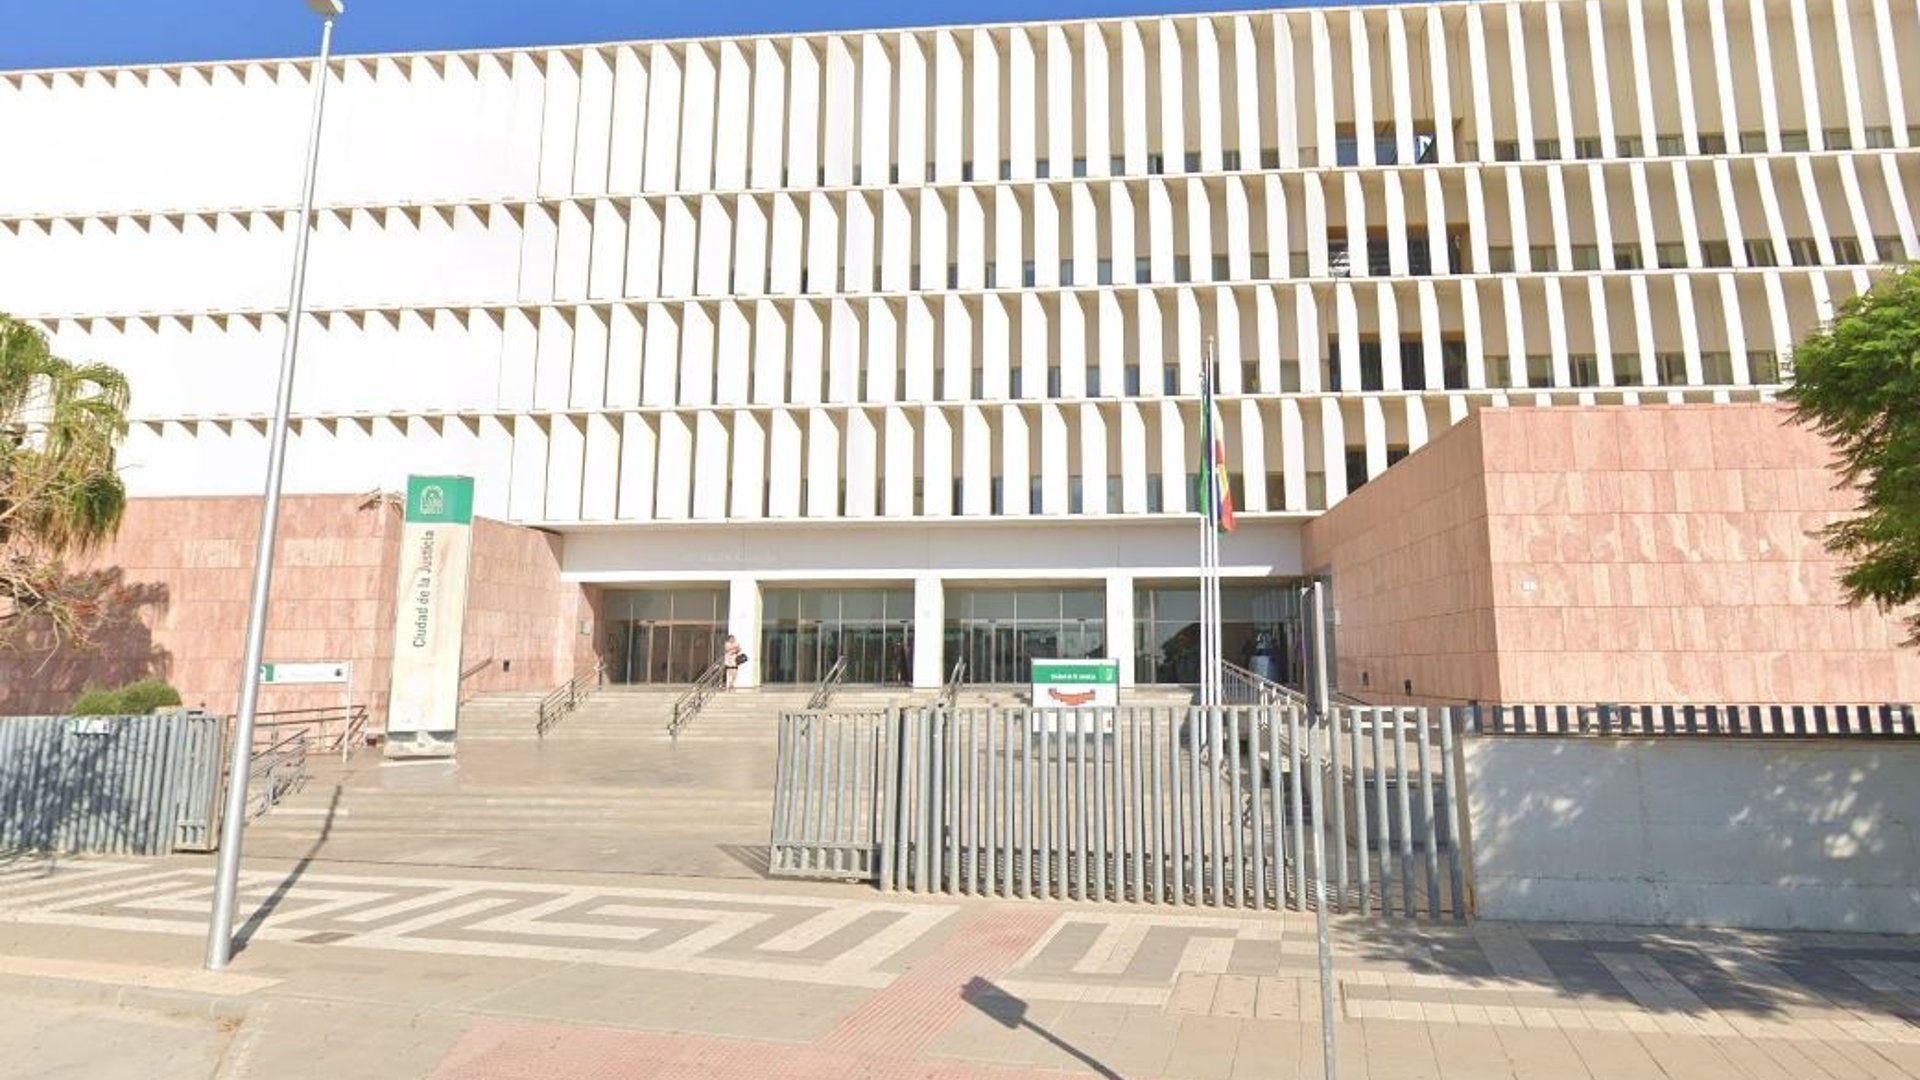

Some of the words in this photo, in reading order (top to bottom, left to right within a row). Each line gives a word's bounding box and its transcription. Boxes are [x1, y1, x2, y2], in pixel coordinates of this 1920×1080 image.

[418, 530, 434, 573] Justicia
[417, 577, 430, 588] la
[416, 590, 430, 605] de
[413, 607, 428, 648] Ciudad
